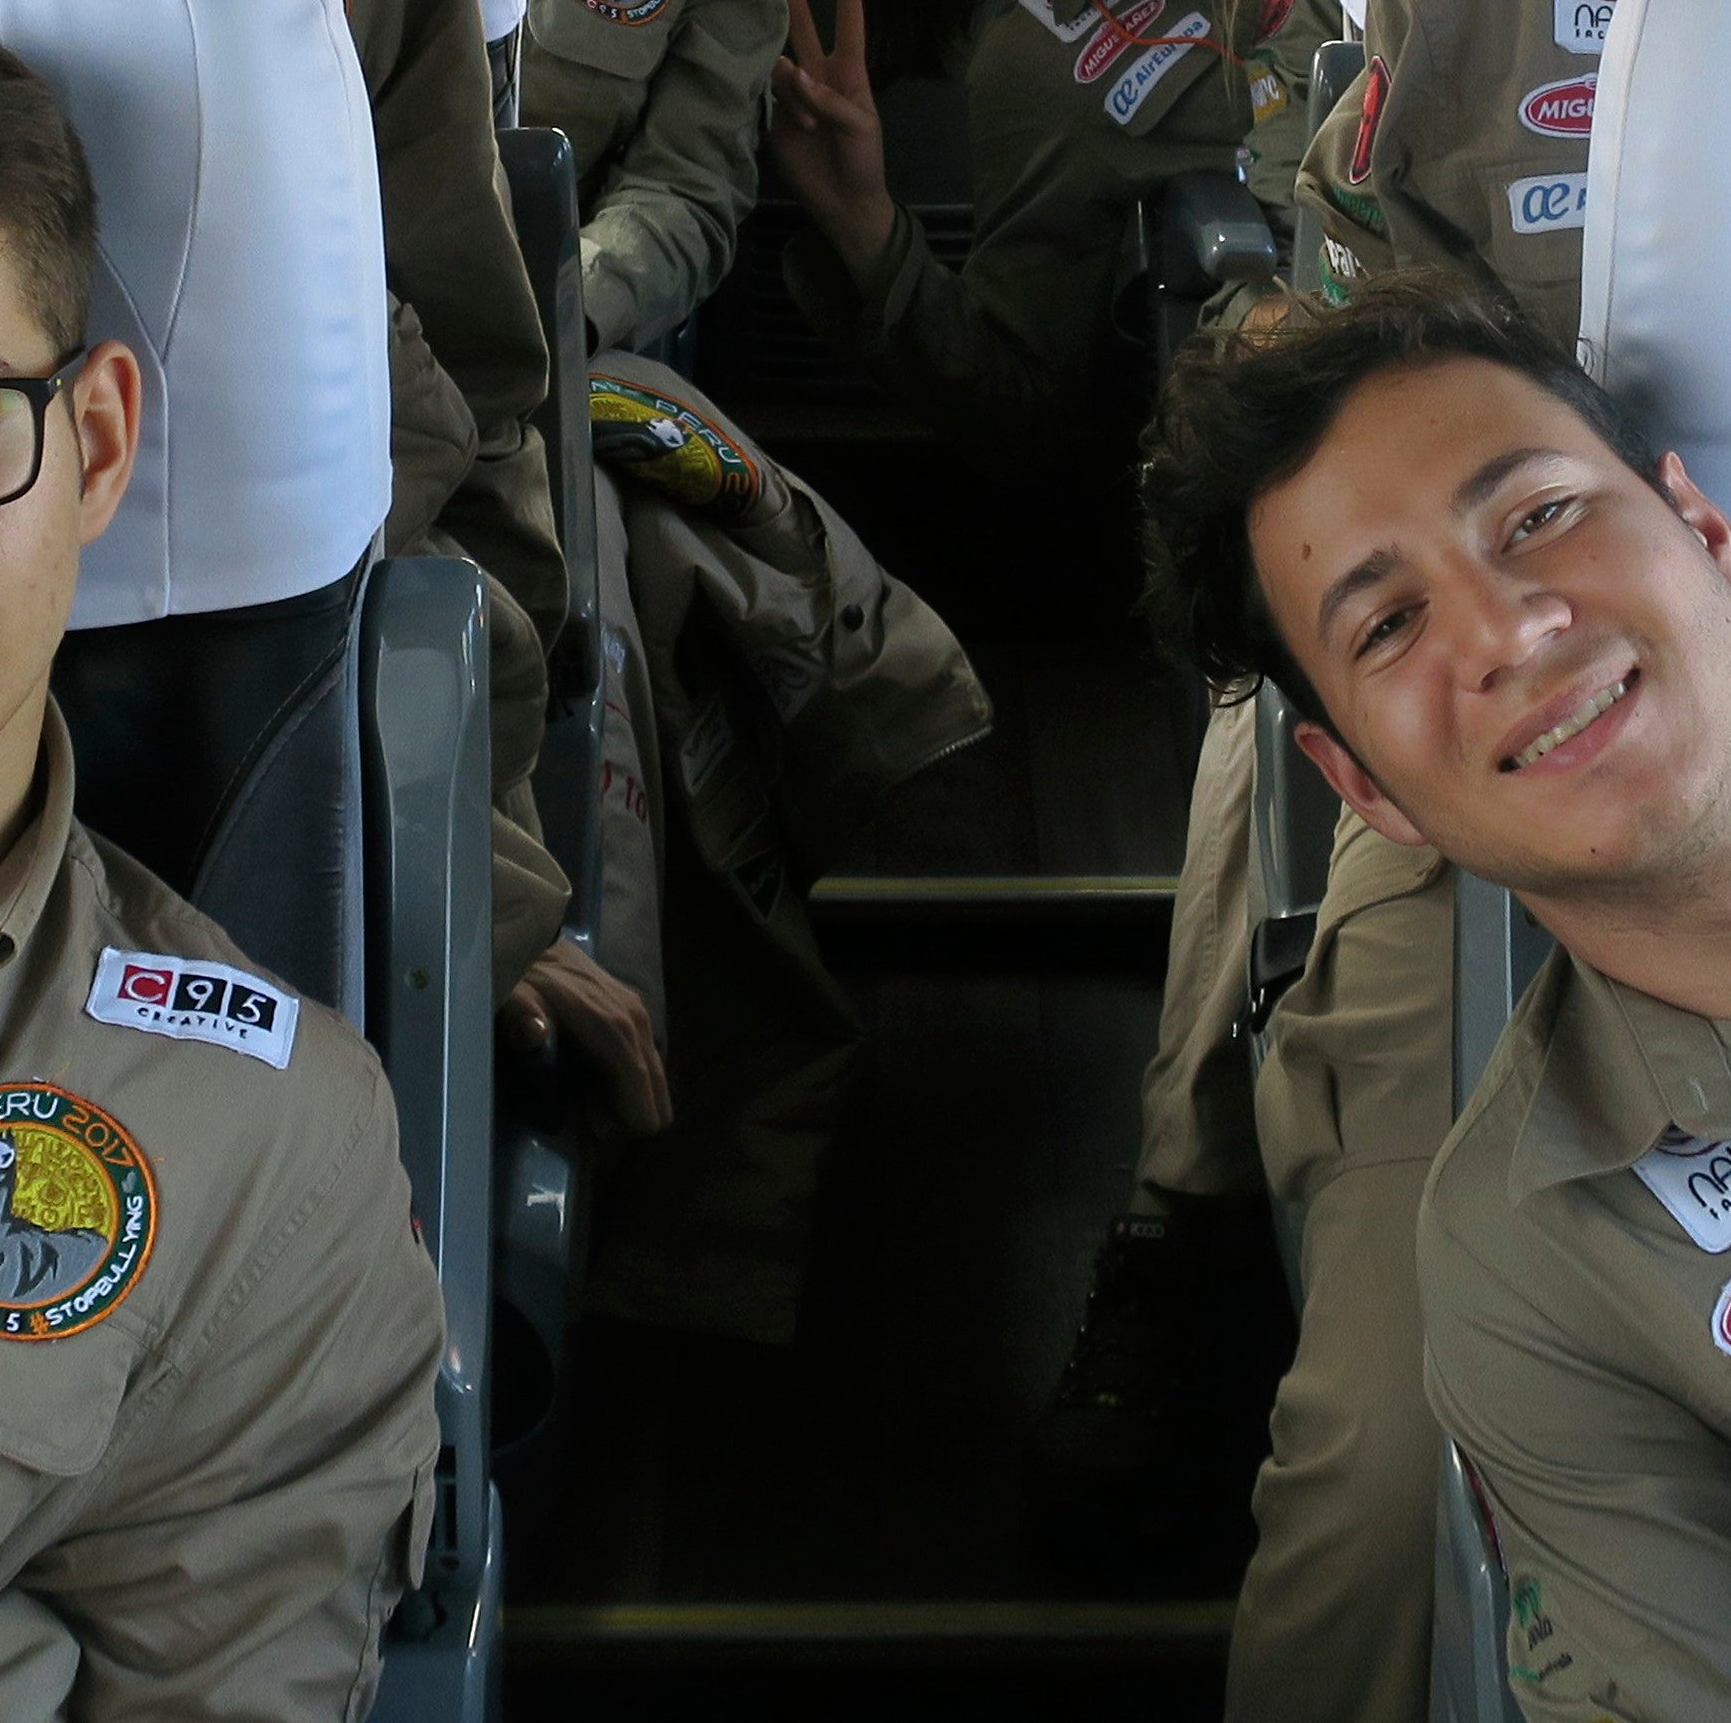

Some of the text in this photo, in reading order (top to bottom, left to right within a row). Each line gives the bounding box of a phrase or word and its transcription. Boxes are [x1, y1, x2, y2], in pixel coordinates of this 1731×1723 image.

[1083, 0, 1158, 77] MIGUEAÑEZ
[120, 970, 267, 1027] C95
[136, 1006, 250, 1040] CREATIVE
[61, 1104, 137, 1168] 2017
